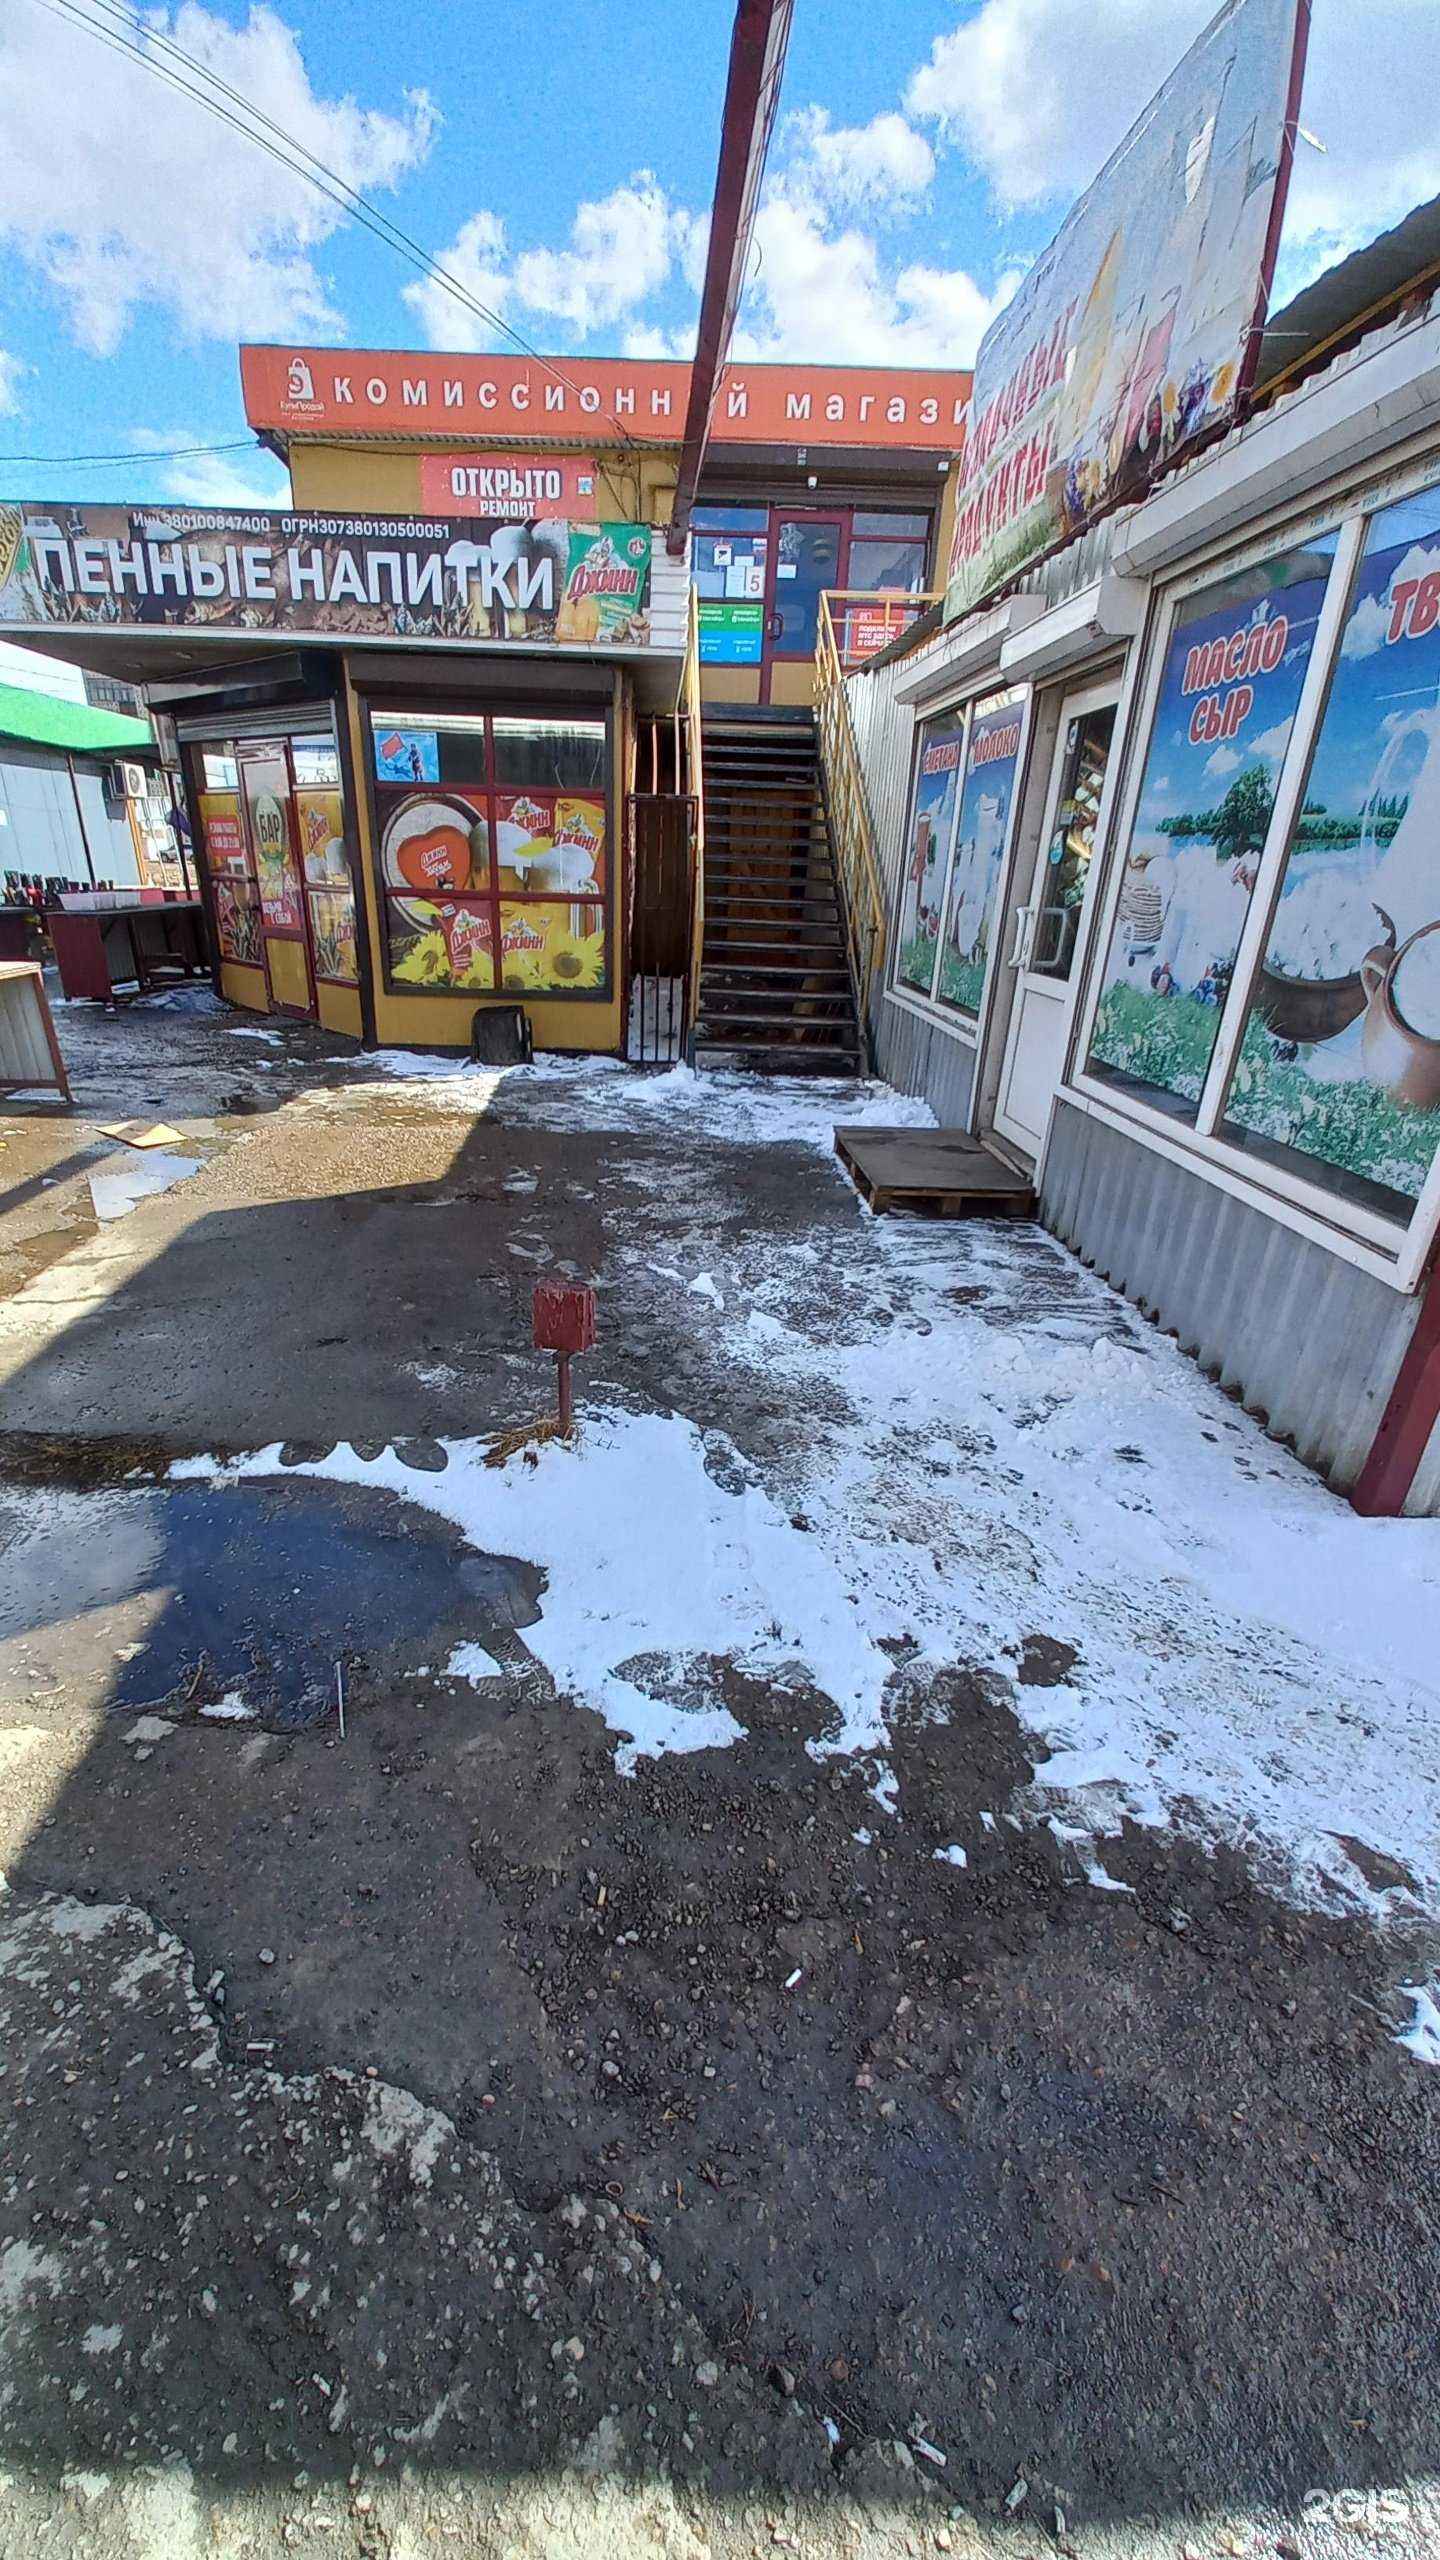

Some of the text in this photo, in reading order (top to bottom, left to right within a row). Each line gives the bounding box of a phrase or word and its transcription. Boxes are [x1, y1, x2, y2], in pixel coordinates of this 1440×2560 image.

[451, 467, 562, 499] ОТКРЫТО
[480, 500, 536, 516] РЕМОНТ
[34, 538, 277, 599] ПЕННЫЕ
[287, 547, 553, 610] НАПИТКИ
[1183, 616, 1288, 694] МАСЛО
[1190, 686, 1252, 744] СЫР
[259, 813, 281, 844] БАР
